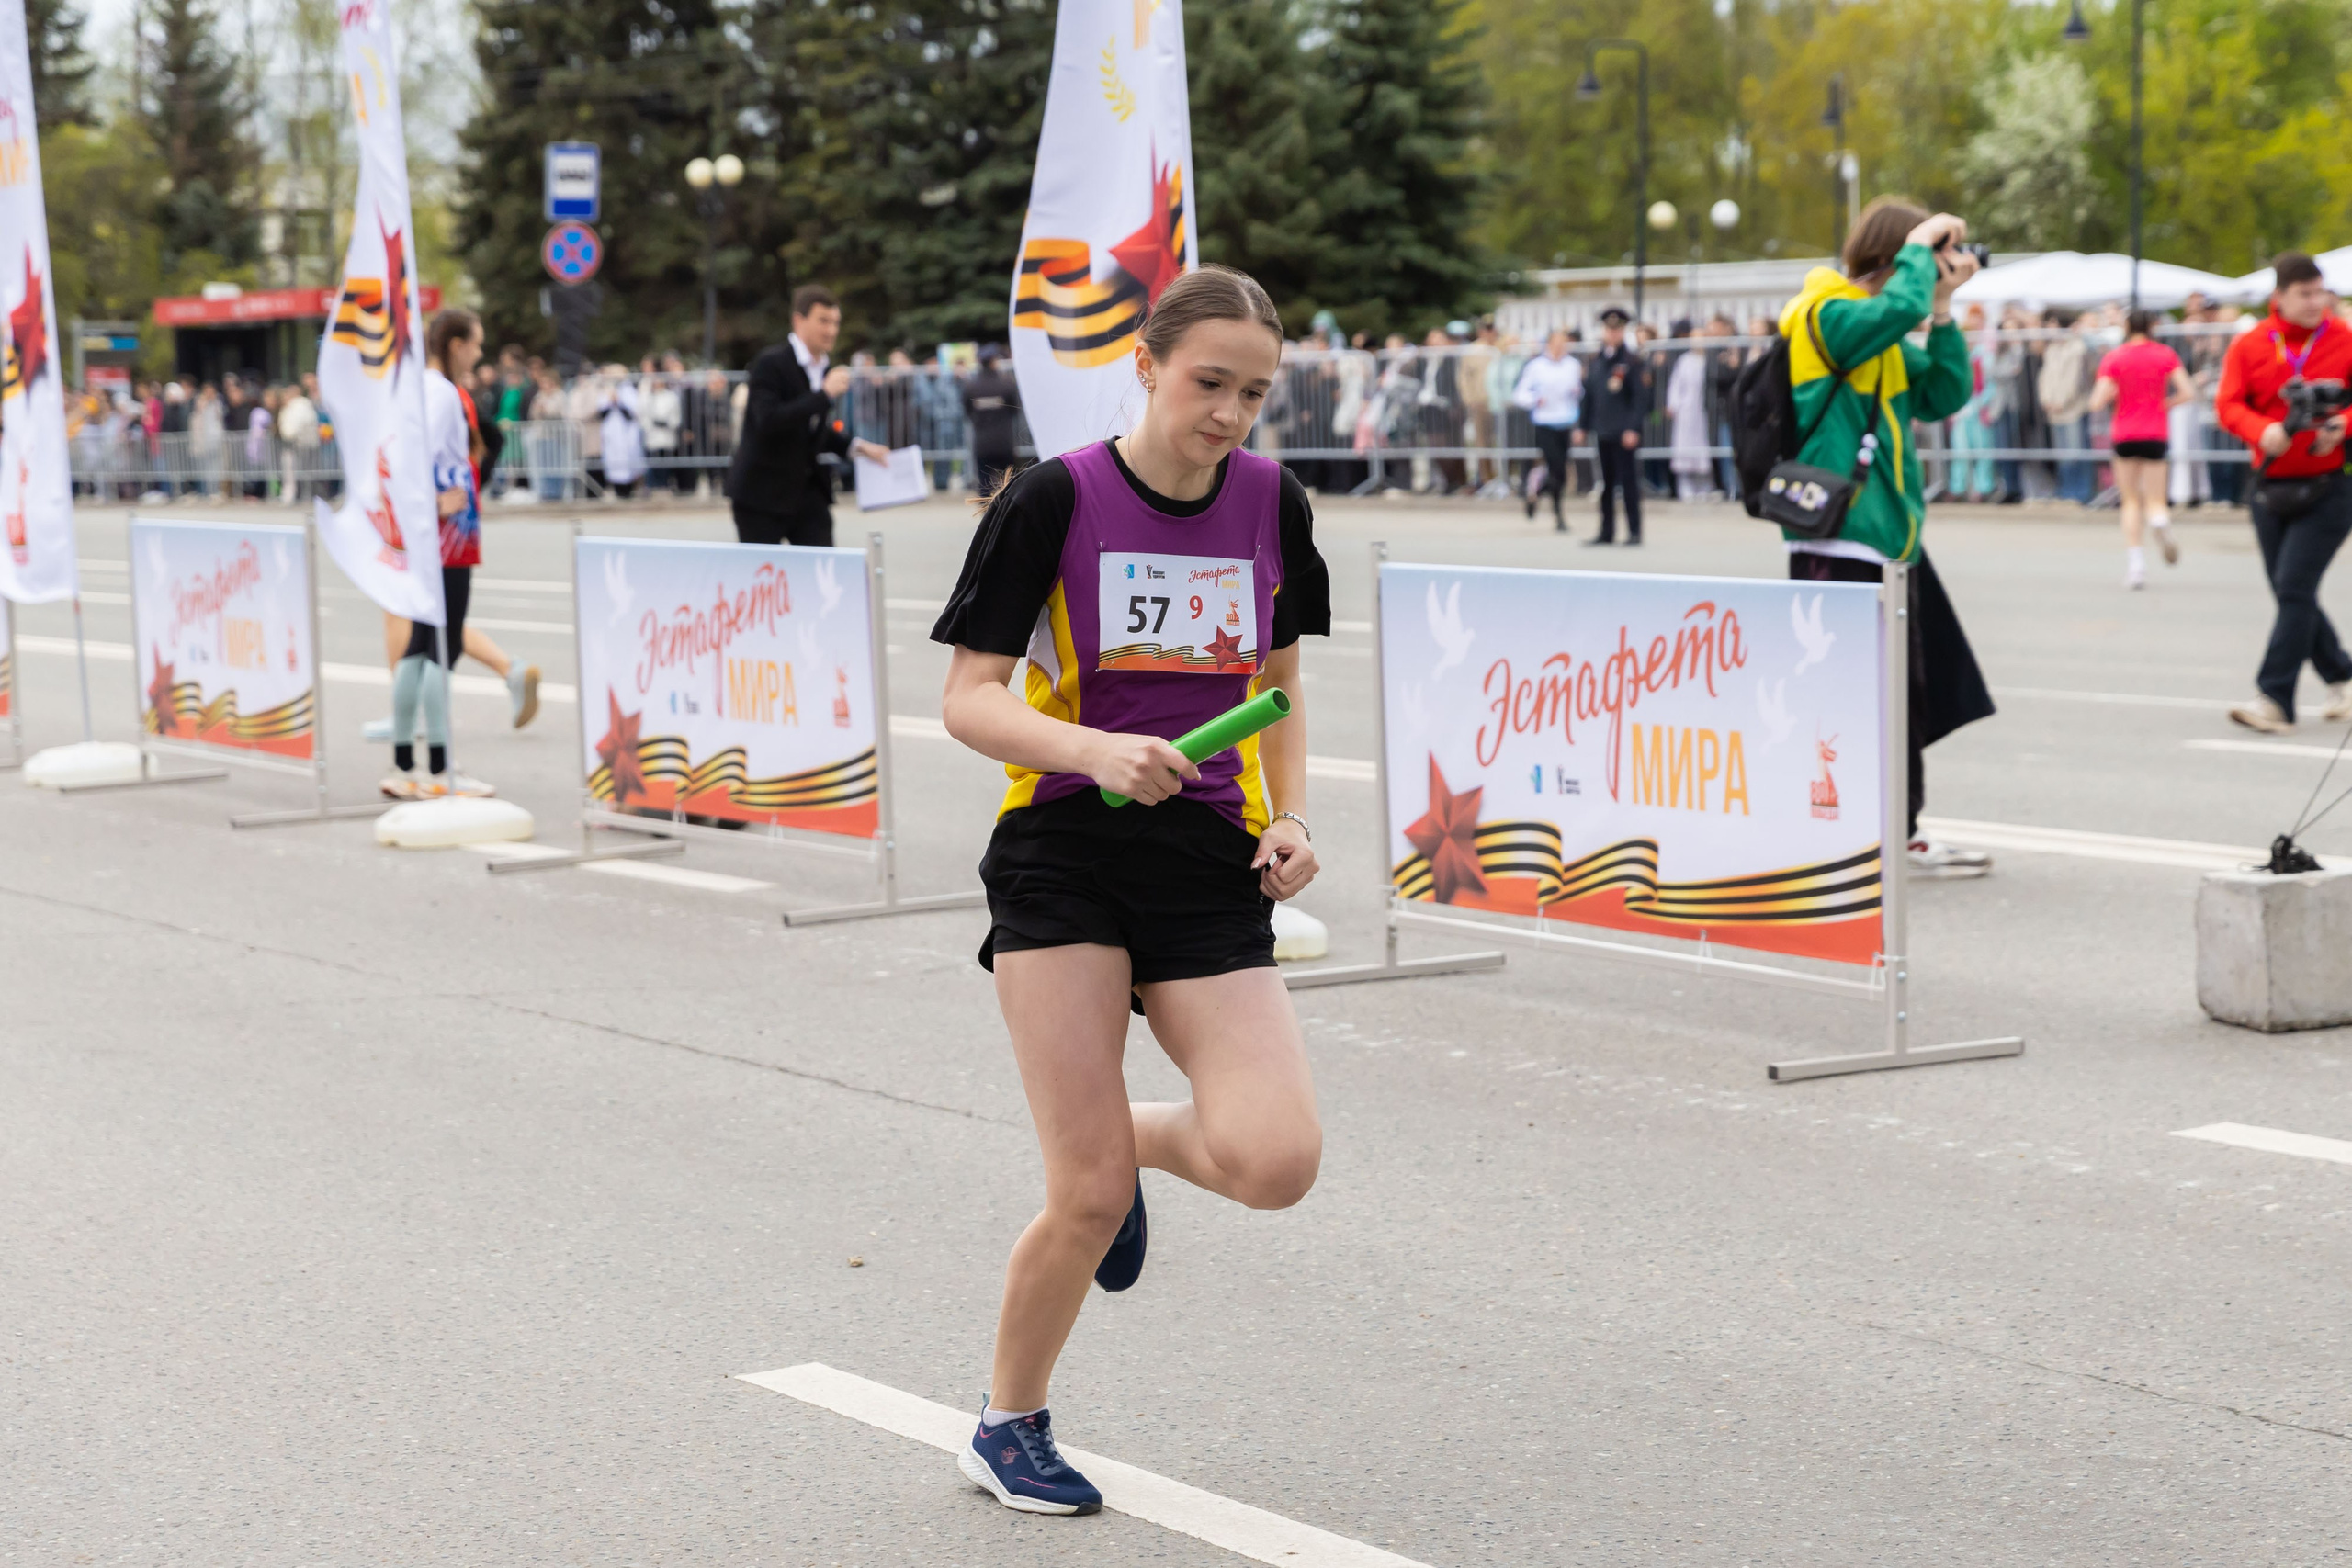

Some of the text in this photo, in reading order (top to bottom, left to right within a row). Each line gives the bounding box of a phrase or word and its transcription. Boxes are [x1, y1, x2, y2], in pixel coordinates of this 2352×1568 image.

[1188, 564, 1240, 587] Эстафета
[1189, 595, 1203, 620] 9
[636, 562, 792, 719] Эстафета
[1127, 595, 1170, 634] 57
[727, 657, 797, 727] МИРА
[1476, 601, 1747, 801] Эстафета
[1632, 723, 1750, 816] МИРА
